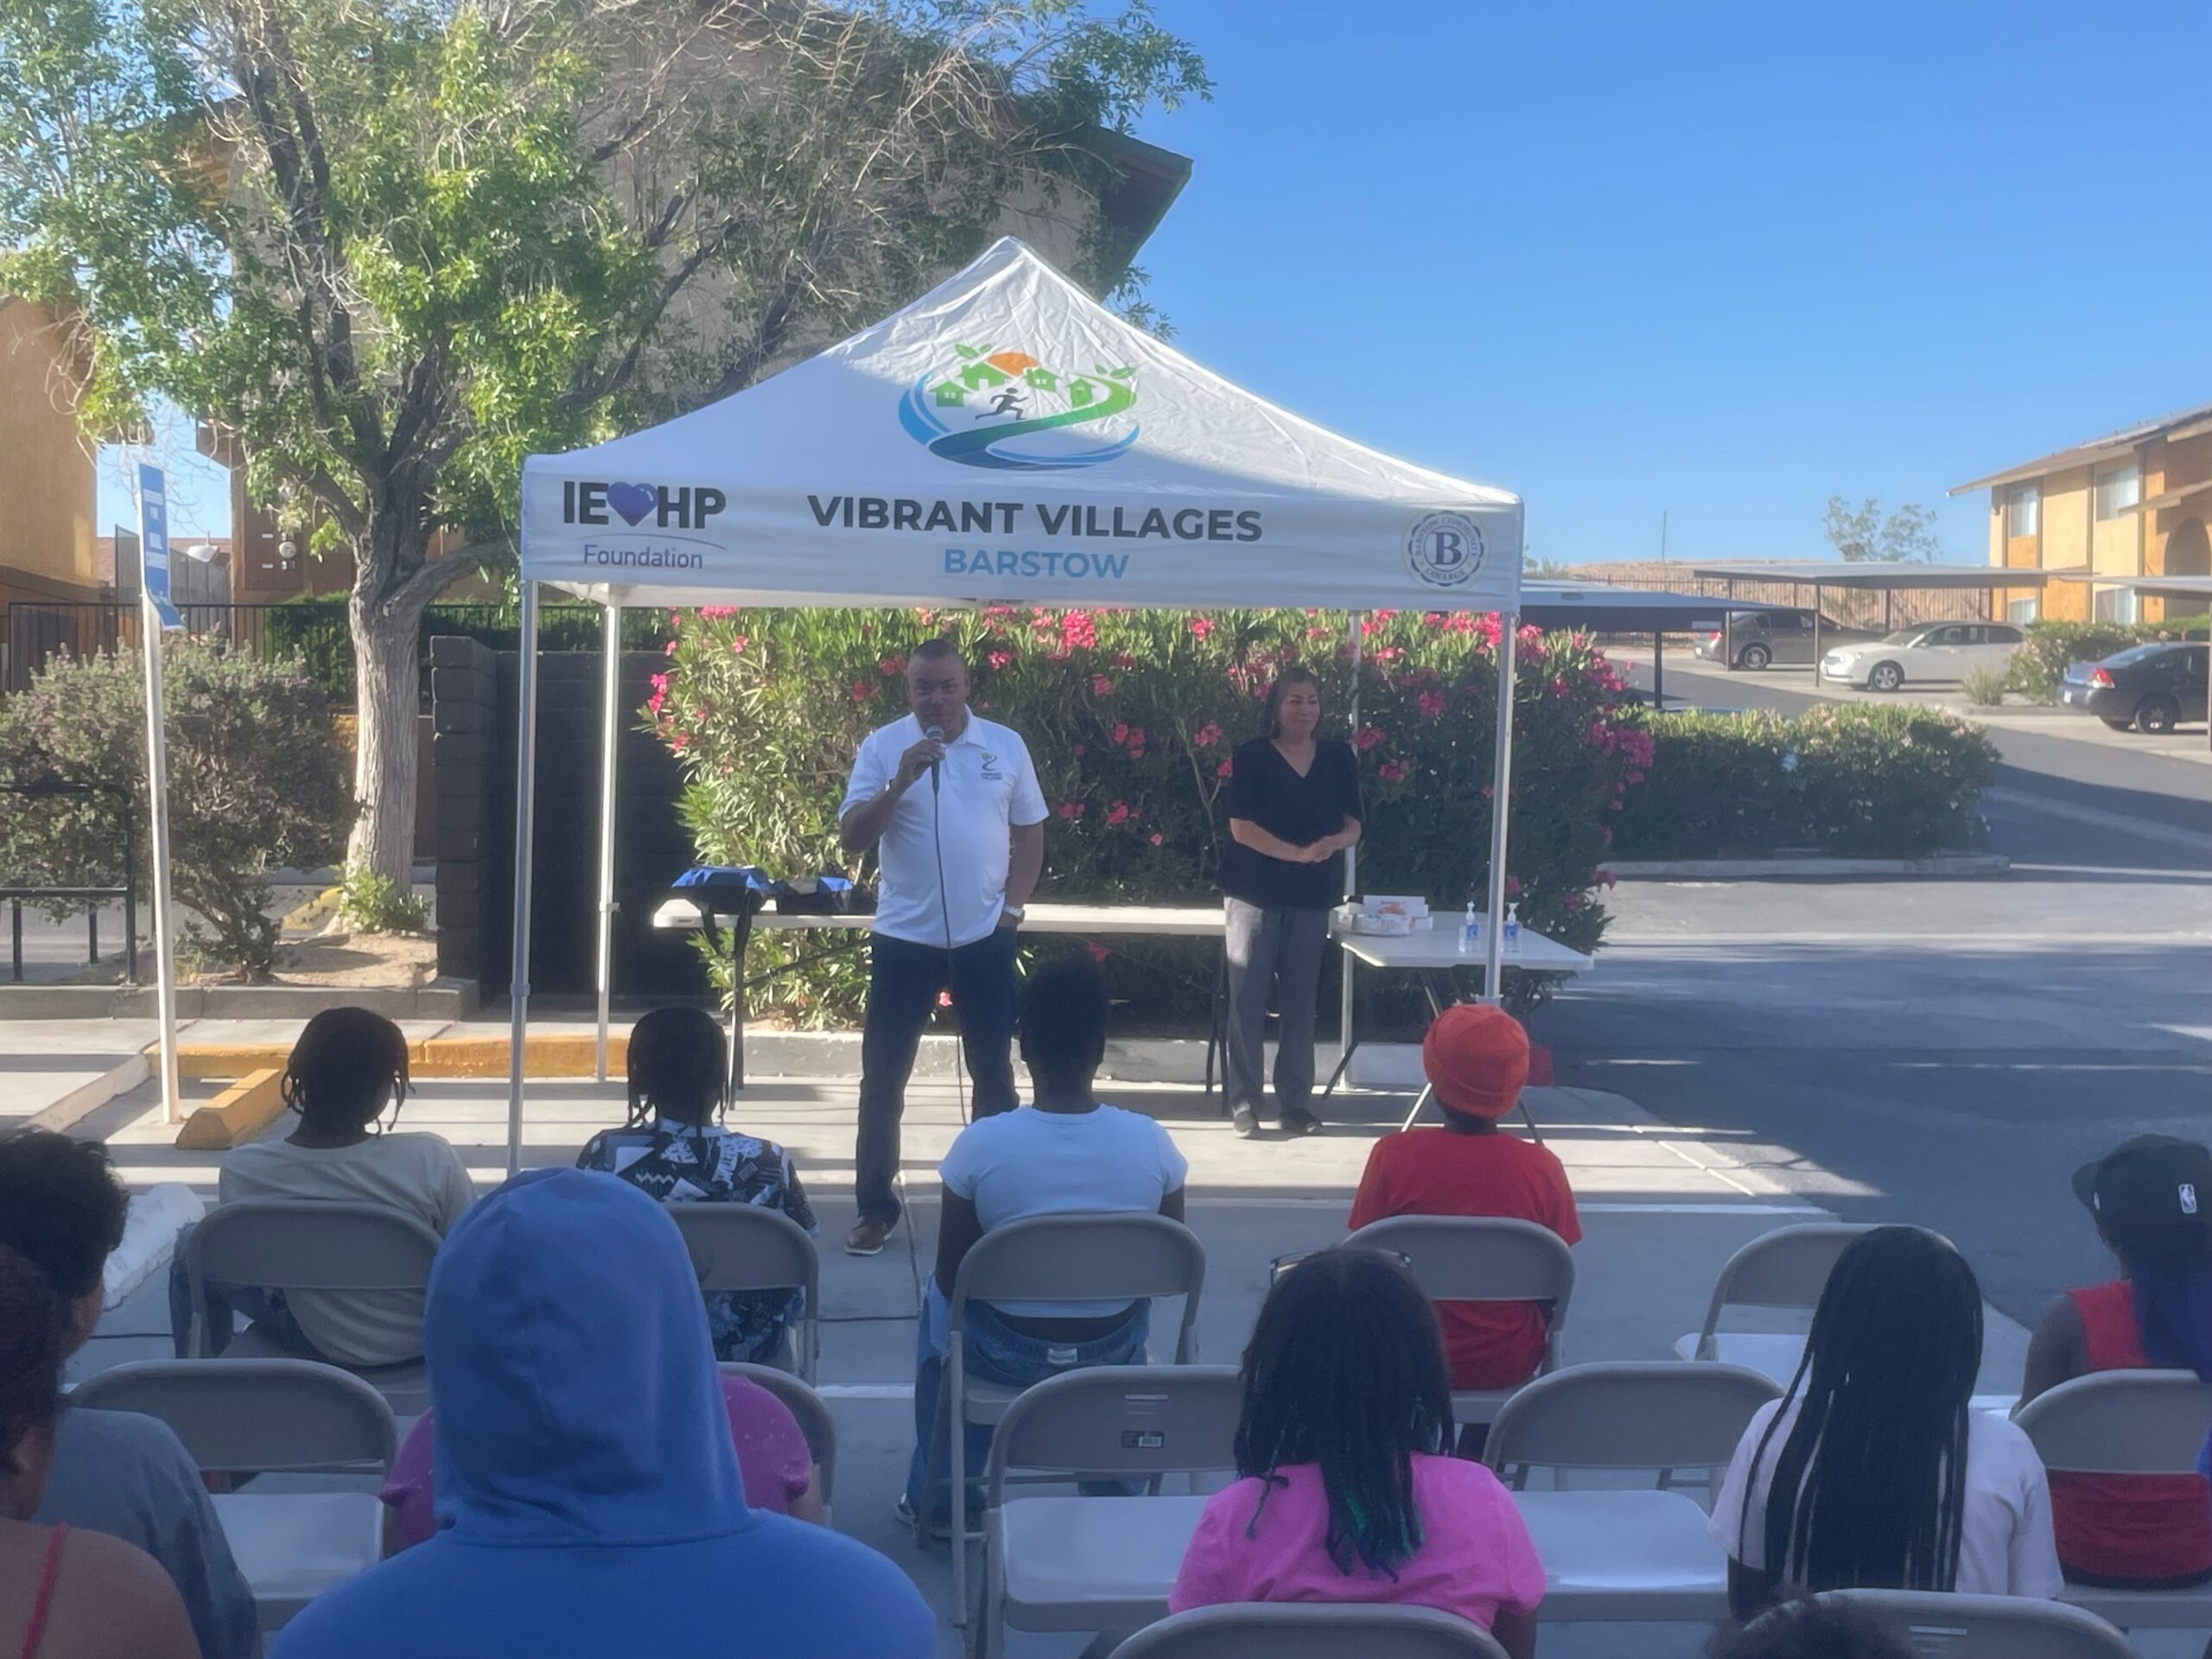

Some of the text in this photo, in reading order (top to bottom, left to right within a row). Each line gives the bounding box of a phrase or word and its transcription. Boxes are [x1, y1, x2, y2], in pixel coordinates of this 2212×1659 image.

[807, 495, 1263, 543] VIBRANT VILLAGES
[583, 544, 703, 569] Foundation
[944, 548, 1130, 579] BARSTOW
[1432, 531, 1462, 566] B
